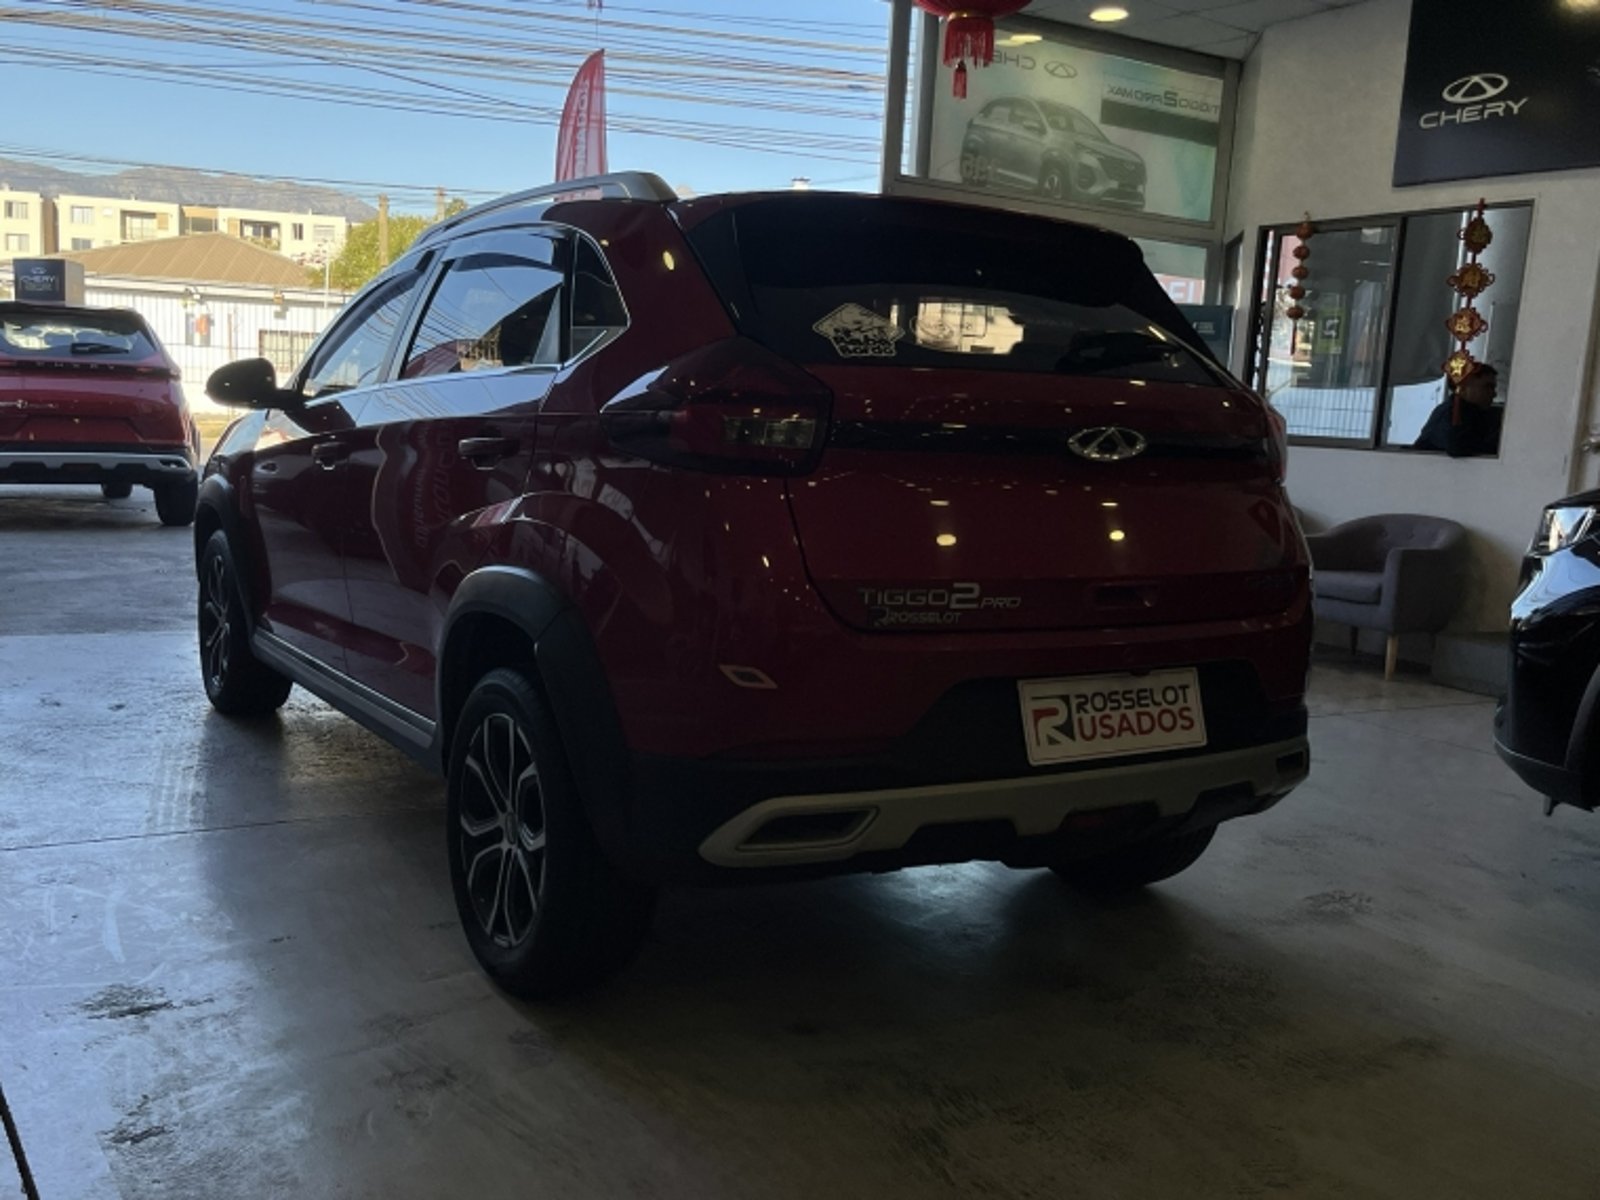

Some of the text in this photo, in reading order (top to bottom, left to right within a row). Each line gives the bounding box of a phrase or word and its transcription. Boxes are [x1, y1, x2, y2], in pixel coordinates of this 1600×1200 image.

[1419, 96, 1530, 129] CHERY
[858, 588, 949, 606] TIGGO
[980, 596, 1022, 609] PRO
[887, 611, 964, 625] ROSSELOT
[1074, 685, 1191, 714] ROSSELOT
[1077, 707, 1195, 741] USADOS
